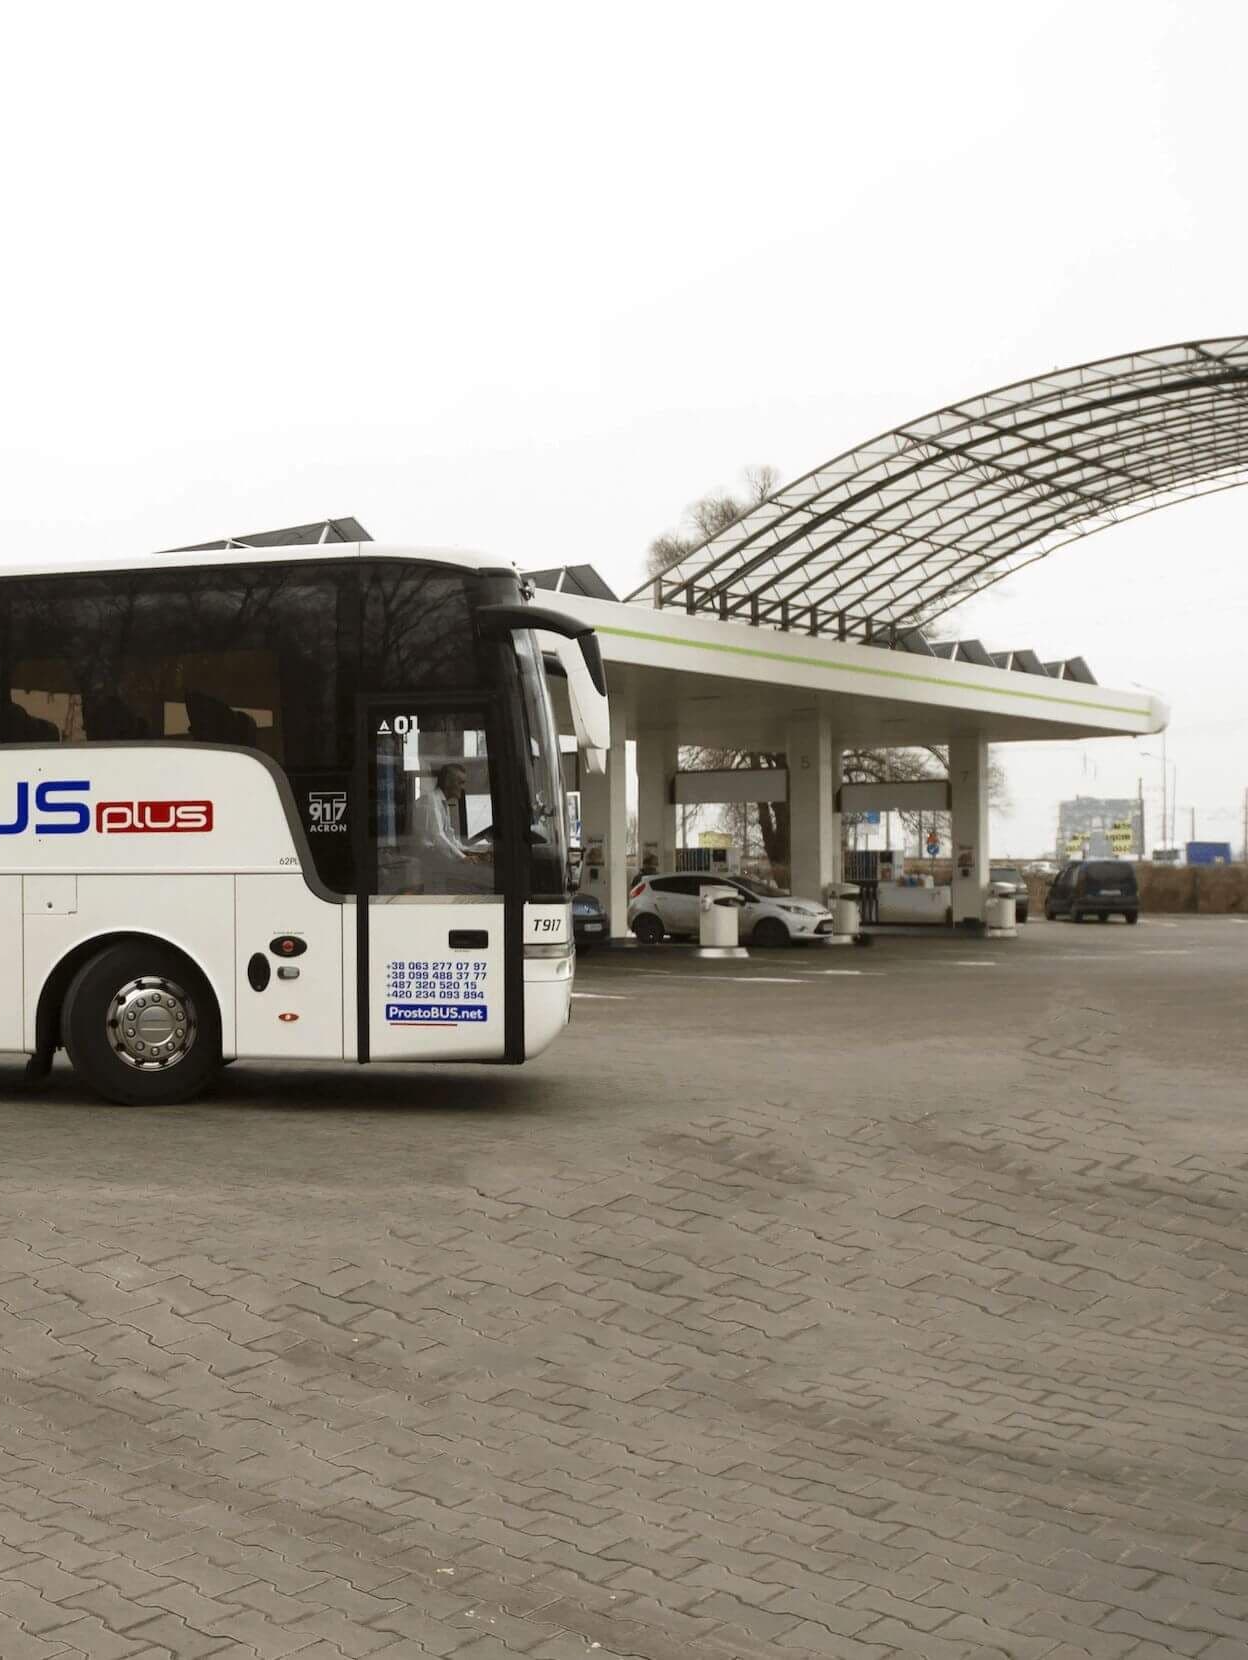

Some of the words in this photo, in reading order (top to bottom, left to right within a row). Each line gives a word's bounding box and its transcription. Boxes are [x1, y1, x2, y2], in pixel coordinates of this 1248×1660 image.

[394, 715, 420, 735] 01
[102, 801, 208, 833] plus
[310, 824, 347, 832] ACRON
[533, 919, 562, 932] T917
[386, 962, 405, 970] +38
[408, 962, 429, 970] 063
[432, 962, 452, 970] 277
[456, 962, 470, 970] 07
[473, 962, 487, 970] 97
[386, 971, 405, 980] +38
[408, 971, 429, 980] 099
[432, 971, 453, 980] 488
[456, 971, 470, 980] 37
[473, 971, 487, 980] 77
[386, 981, 412, 989] +487
[415, 981, 436, 989] 320
[439, 981, 460, 989] 520
[464, 981, 477, 989] 15
[386, 990, 412, 999] +420
[415, 990, 436, 999] 234
[439, 990, 460, 999] 093
[463, 990, 484, 999] 894
[389, 1006, 484, 1019] ProstoBUS.net
